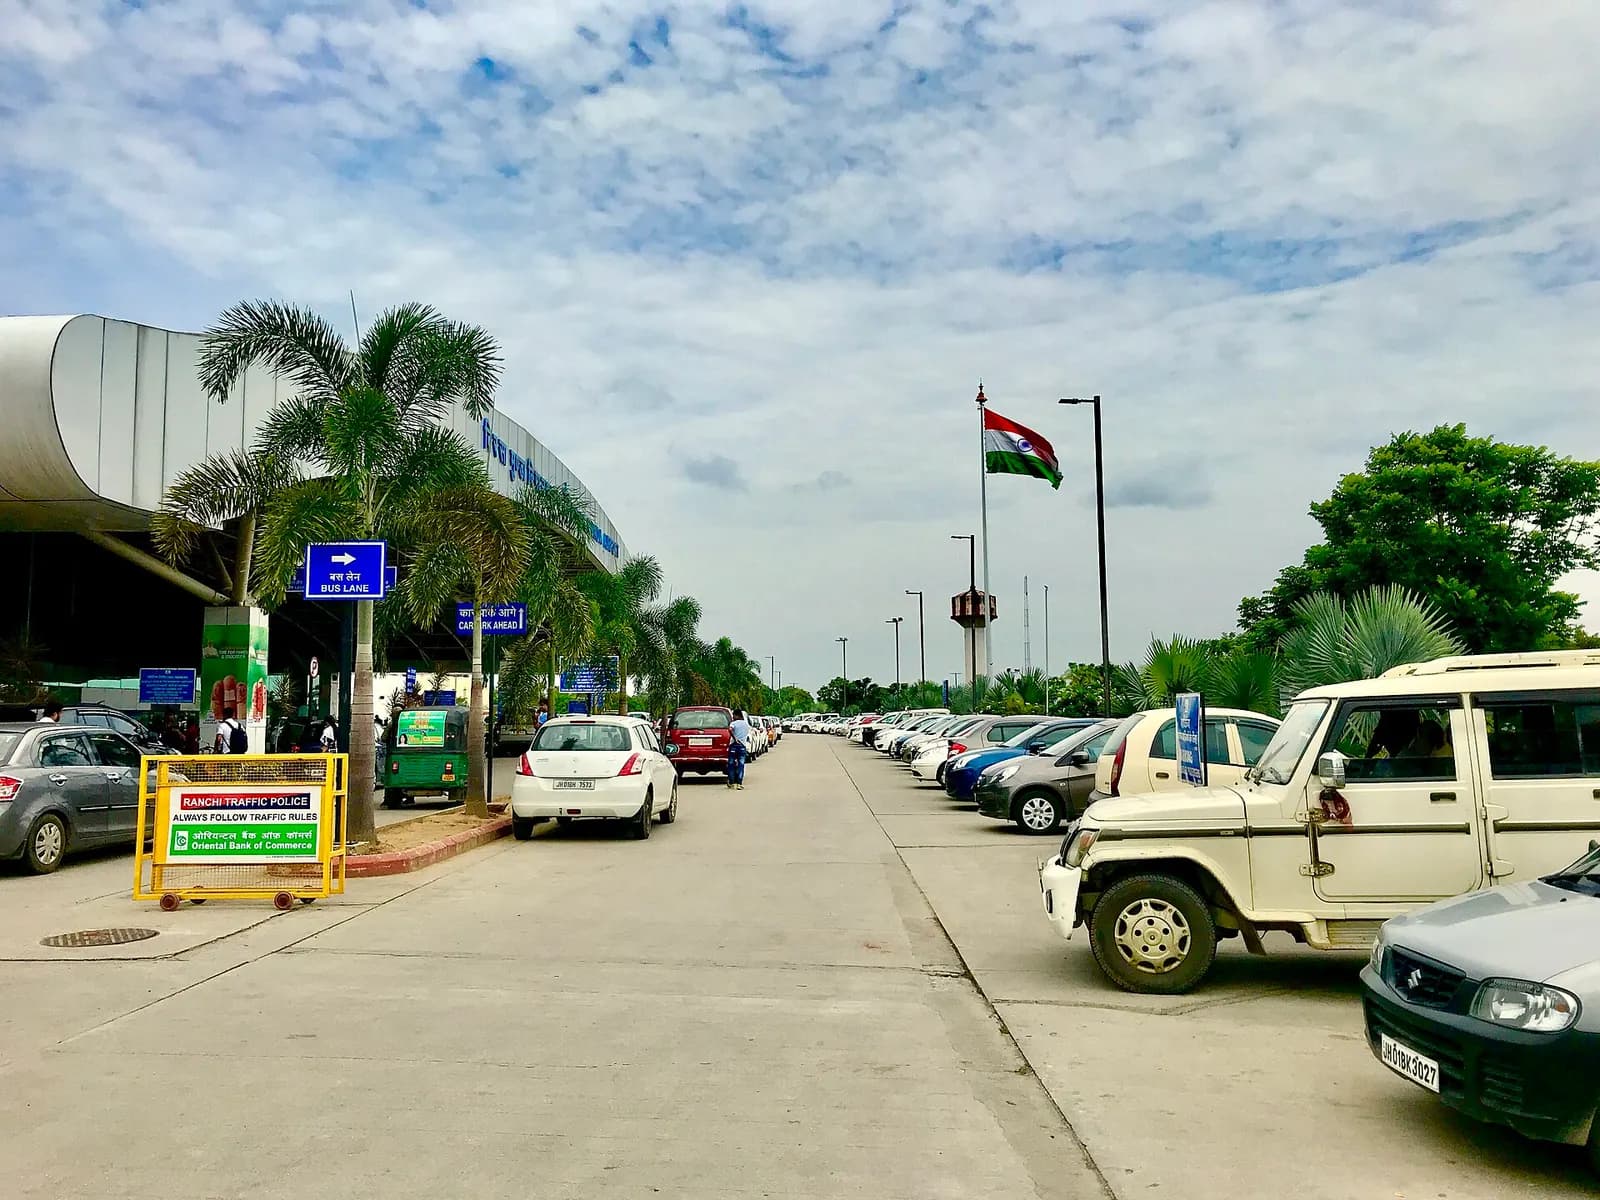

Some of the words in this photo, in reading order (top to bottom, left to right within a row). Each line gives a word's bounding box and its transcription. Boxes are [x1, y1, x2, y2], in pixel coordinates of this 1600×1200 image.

[329, 573, 344, 582] बस
[345, 570, 361, 582] लेन
[321, 584, 341, 593] BUS
[343, 584, 369, 593] LANE
[498, 605, 516, 617] आगे
[493, 621, 518, 630] AHEAD
[183, 797, 223, 807] RANCHI
[225, 797, 268, 807] TRAFFIC
[270, 797, 309, 806] POLICE
[173, 813, 208, 822] ALWAYS
[210, 813, 248, 822] FOLLOW
[249, 813, 287, 821] TRAFFIC
[288, 813, 318, 821] RULES
[191, 841, 227, 850] Oriental
[229, 841, 251, 850] Bank
[253, 841, 263, 849] of
[265, 841, 313, 849] Commerce
